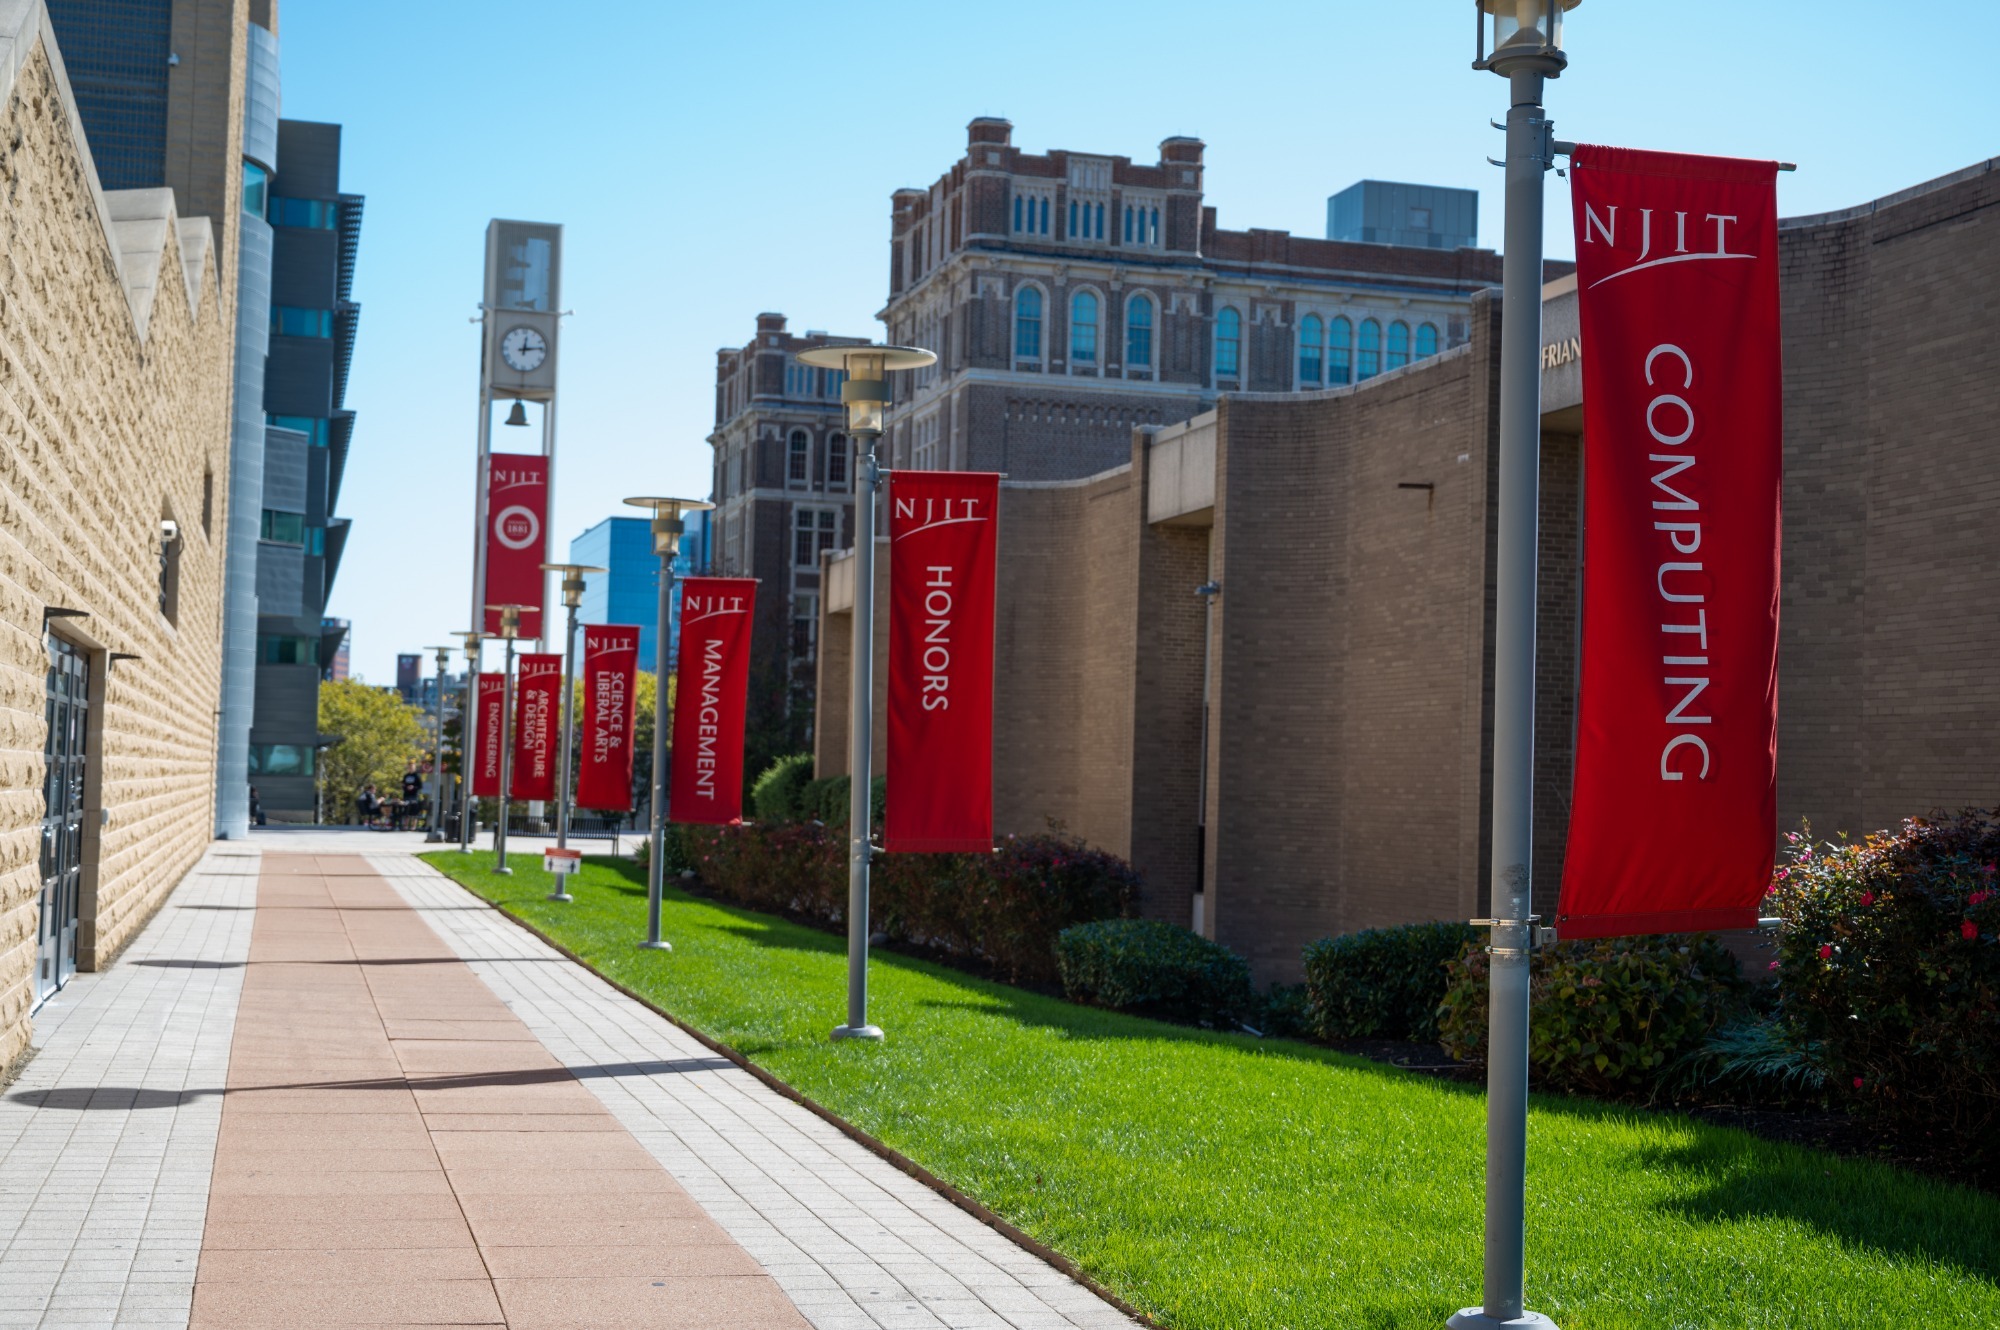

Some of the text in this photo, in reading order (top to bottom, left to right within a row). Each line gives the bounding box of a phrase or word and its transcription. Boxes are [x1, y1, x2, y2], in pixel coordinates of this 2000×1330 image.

[1583, 201, 1738, 262] NJIT
[494, 469, 540, 484] NJIT
[508, 525, 527, 534] 1881
[895, 498, 979, 525] NJIT
[1644, 343, 1712, 781] COMPUTING
[686, 596, 743, 613] NJIT
[521, 663, 556, 673] NJIT
[587, 637, 631, 651] NJIT
[922, 566, 952, 711] HONORS
[481, 680, 504, 690] NJI
[609, 672, 624, 748] SCIENCE &
[485, 702, 499, 778] ENGINEERING
[523, 689, 537, 749] & DESIGN
[534, 689, 549, 778] ARCHITECTURE
[594, 671, 610, 763] LIBERAL ARTS
[696, 639, 723, 800] MANAGEMENT
